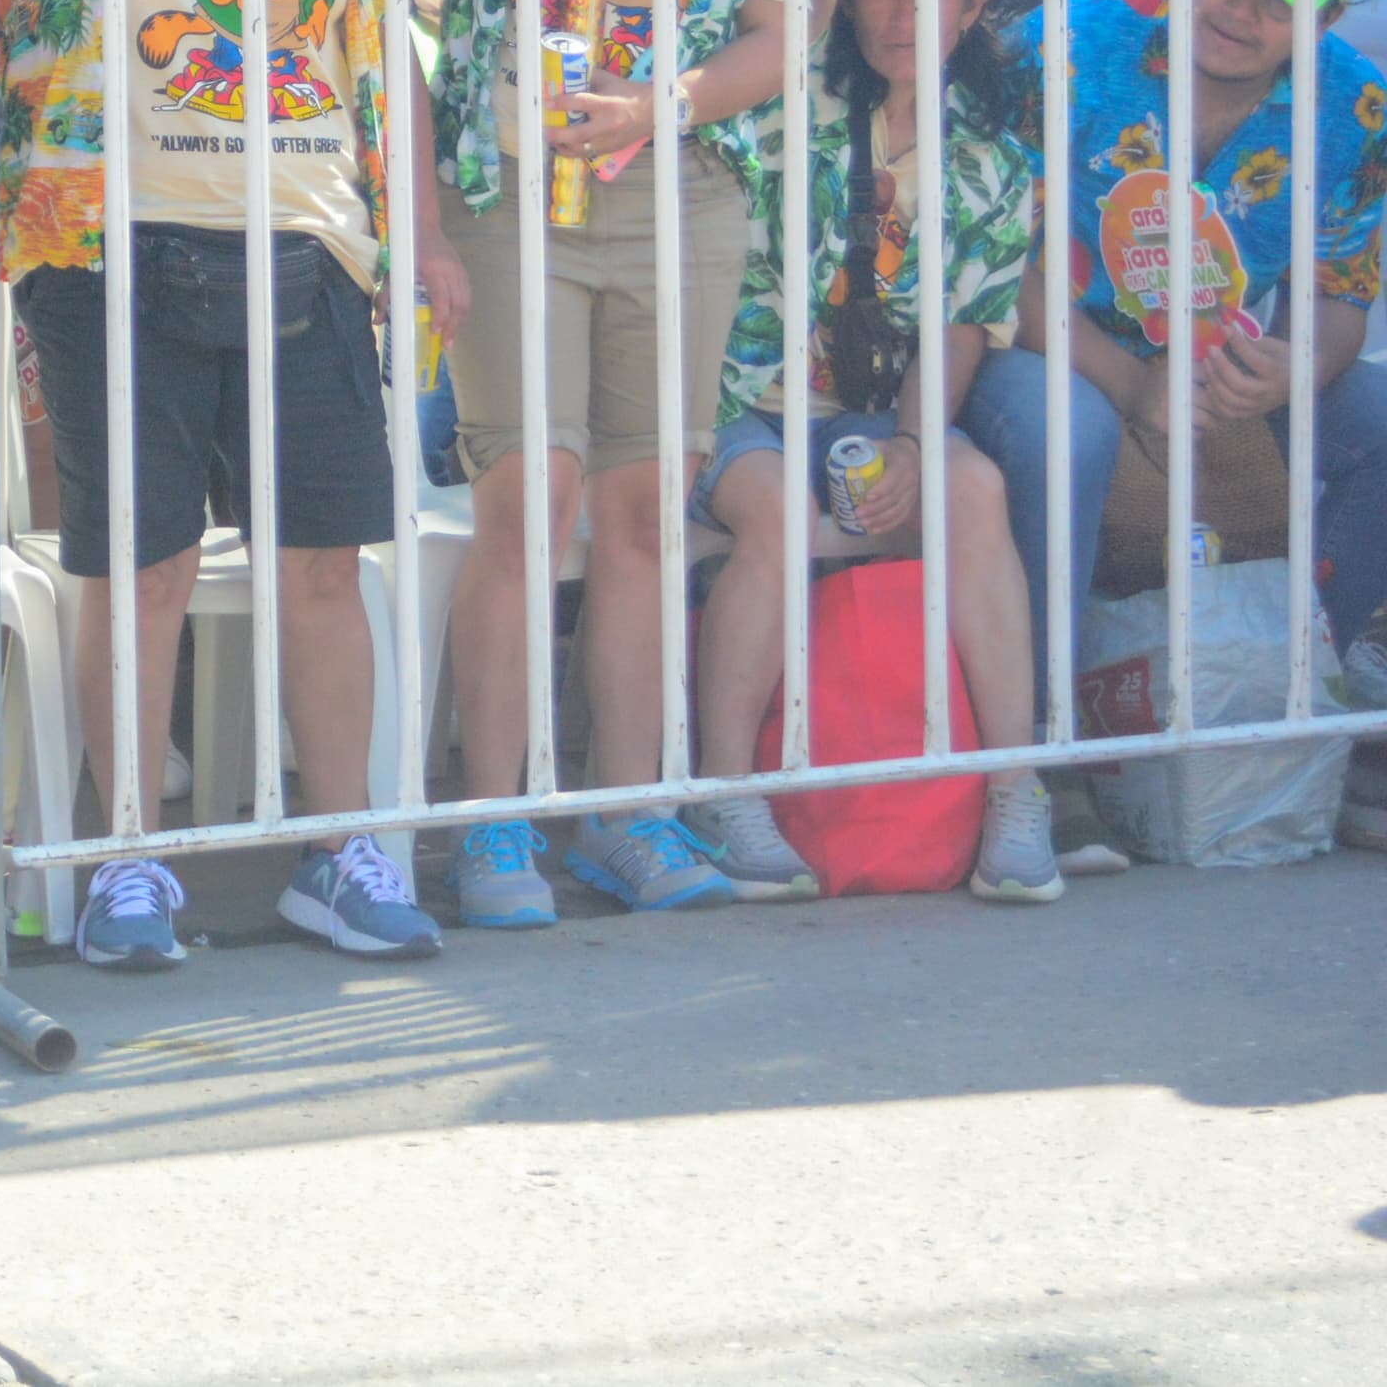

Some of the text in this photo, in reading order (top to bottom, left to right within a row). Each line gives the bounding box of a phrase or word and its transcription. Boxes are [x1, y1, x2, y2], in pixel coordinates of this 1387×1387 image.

[225, 137, 245, 153] GO
[273, 138, 311, 153] OFTEN
[1131, 208, 1165, 228] ara
